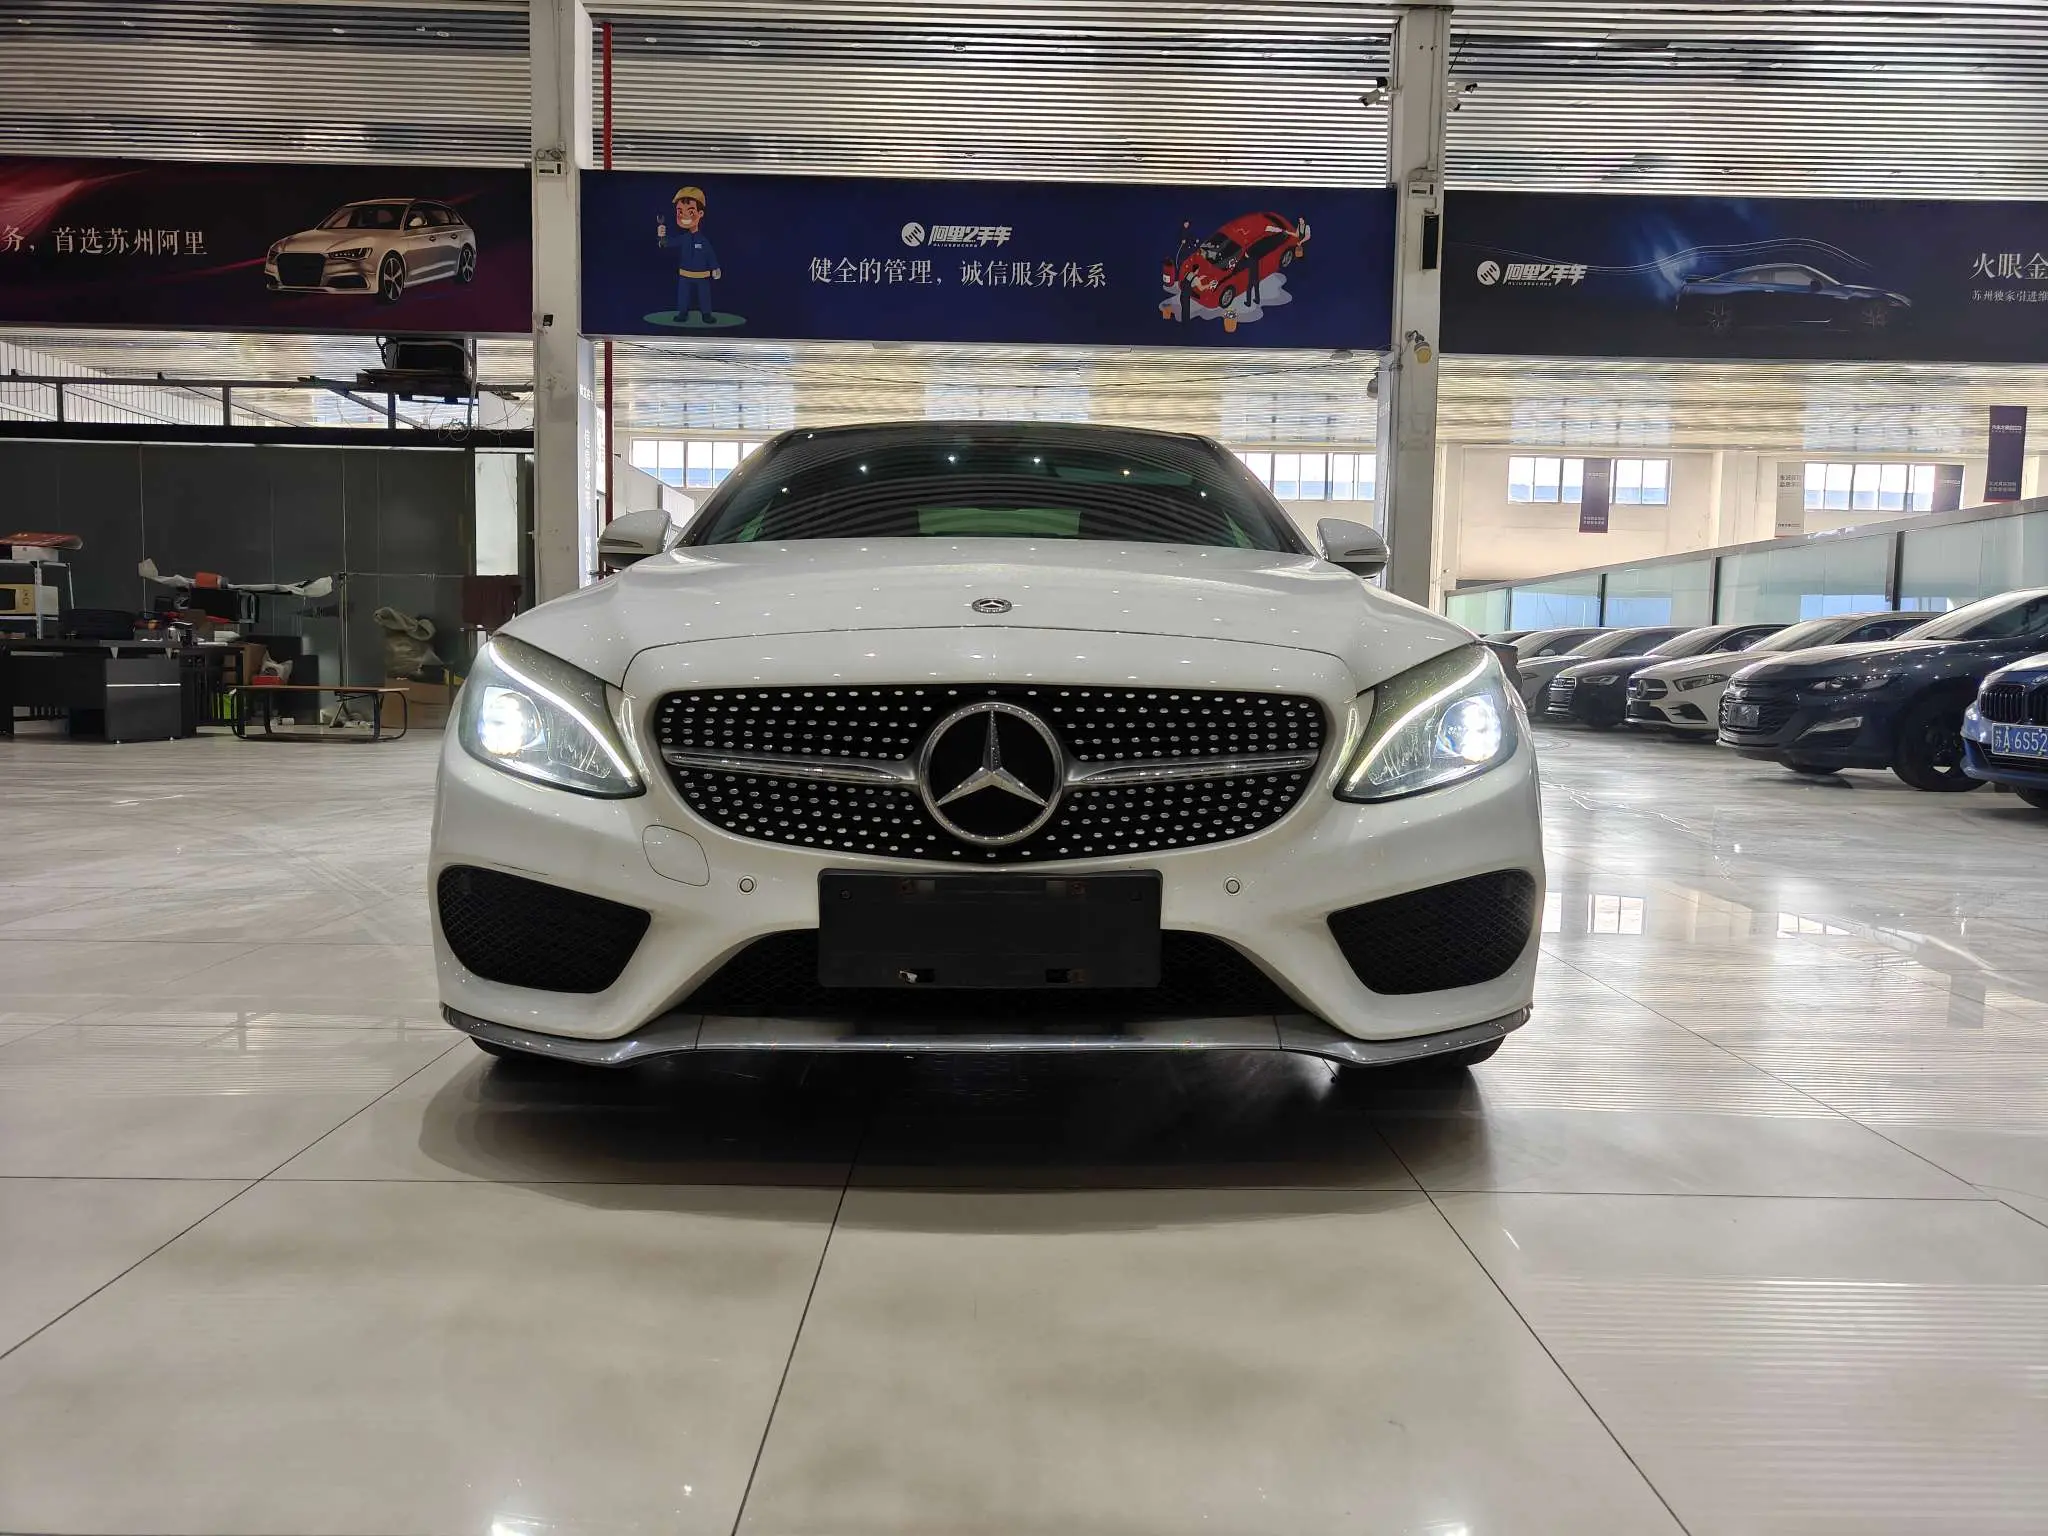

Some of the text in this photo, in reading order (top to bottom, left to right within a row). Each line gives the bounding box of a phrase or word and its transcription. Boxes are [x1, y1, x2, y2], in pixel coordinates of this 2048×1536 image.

[1, 224, 208, 256] 务，首选苏州阿里
[808, 256, 1106, 288] 健全的管理，诚信服务体系
[1968, 252, 2048, 280] 火眼金
